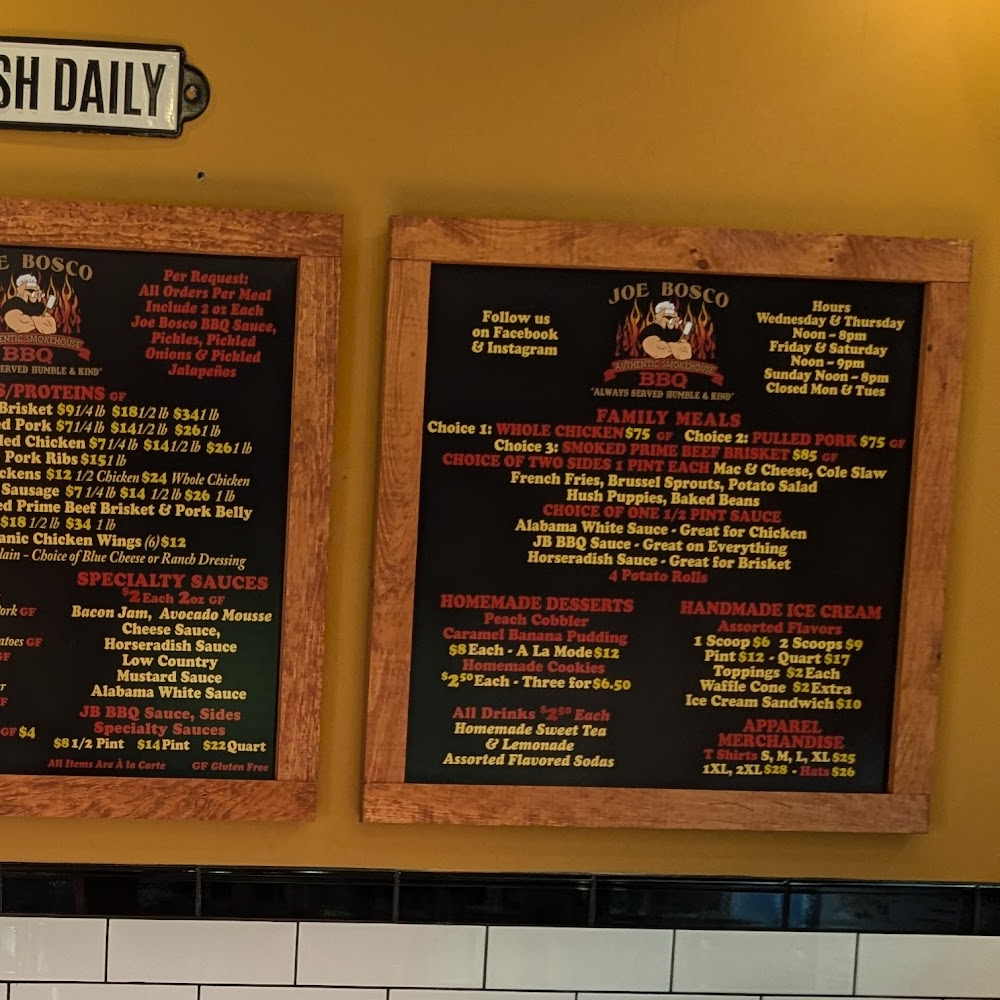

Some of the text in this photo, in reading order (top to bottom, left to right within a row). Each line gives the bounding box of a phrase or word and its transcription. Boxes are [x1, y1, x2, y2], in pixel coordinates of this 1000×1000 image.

[54, 58, 166, 116] DAILY
[164, 270, 248, 286] Per Request:
[608, 282, 730, 308] JOE BOSCO
[812, 301, 851, 313] Hours
[482, 310, 550, 324] Follow us
[757, 312, 905, 331] Wednesday & Thursday
[472, 326, 558, 340] on Facebook
[27, 335, 84, 348] SMOKEHOUSE
[472, 341, 557, 357] & Instagram
[32, 366, 67, 375] HUMBLE
[69, 367, 75, 375] &
[639, 372, 688, 388] BBQ
[110, 392, 126, 401] GF
[766, 382, 885, 396] Closed Mon & Tues
[597, 409, 740, 427] FAMILY MEALS
[511, 471, 817, 493] French Fries, Brussel Sprouts, Potato Salad
[17, 499, 61, 513] Prime
[65, 501, 97, 514] Beef
[100, 502, 155, 515] Brisket
[159, 503, 171, 516] &
[175, 504, 211, 517] Pork
[215, 505, 253, 521] Belly
[77, 572, 268, 590] SPECIALTY SAUCES
[441, 594, 633, 612] HOMEMADE DESSERTS
[680, 601, 881, 619] HANDMADE ICE CREAM
[122, 622, 220, 639] Cheese Sauce,
[104, 638, 237, 652] Horseradish Sauce
[122, 654, 218, 670] Low Country
[117, 669, 222, 683] Mustard Sauce
[91, 684, 247, 699] Alabama White Sauce
[454, 722, 606, 736] Homemade Sweet Tea
[743, 719, 821, 733] APPAREL
[486, 738, 574, 751] & Lemonade
[719, 733, 843, 749] MERCHANDISE
